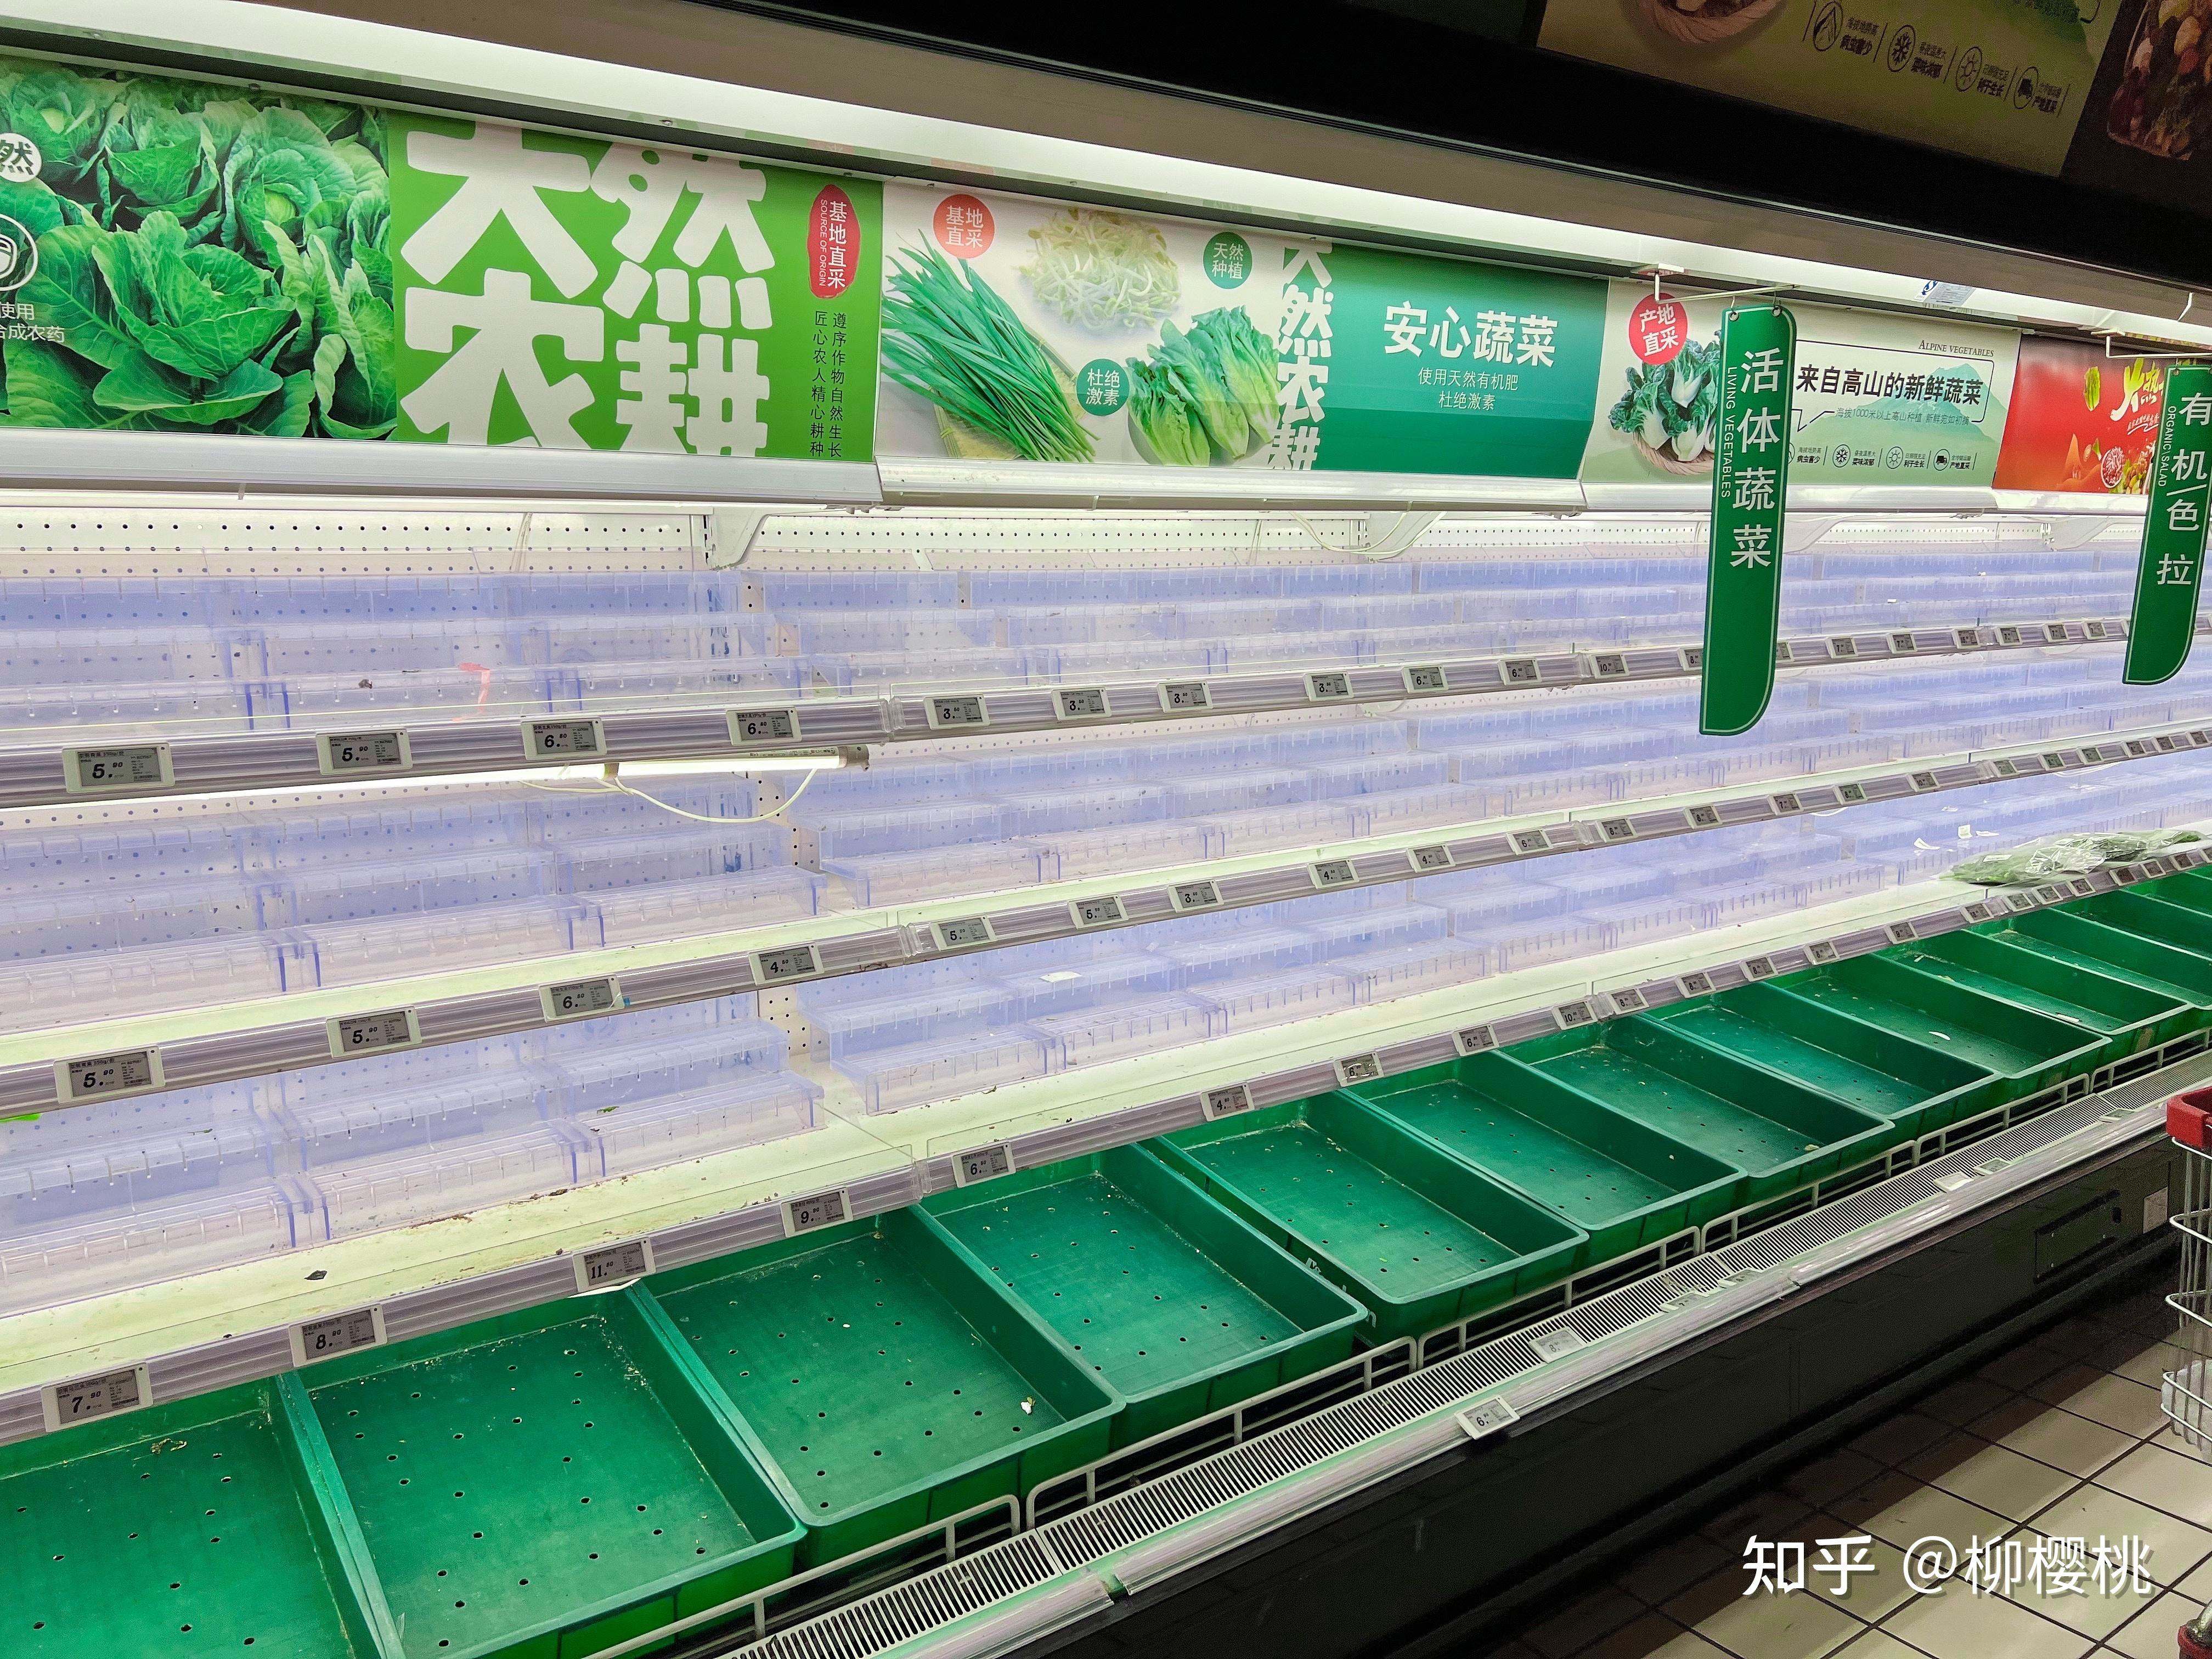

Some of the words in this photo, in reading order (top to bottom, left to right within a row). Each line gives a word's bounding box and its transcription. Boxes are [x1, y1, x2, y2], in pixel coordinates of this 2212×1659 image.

[945, 206, 984, 229] 基地
[820, 240, 827, 253] OF
[827, 200, 848, 289] 基地直采
[945, 225, 984, 249] 直采
[1213, 241, 1244, 262] 天然
[819, 255, 827, 287] ORIGIN
[1212, 259, 1244, 280] 种植
[1639, 303, 1676, 334] 产地
[1383, 300, 1559, 368] 安心蔬菜
[1643, 328, 1679, 357] 直采
[400, 268, 770, 457] 农耕
[1918, 340, 1947, 353] ALPINE
[1949, 345, 1994, 358] VEGETABLES
[810, 311, 828, 457] 匠心农人精心耕种
[828, 312, 847, 458] 遵序作物自然生长
[1086, 368, 1121, 388] 杜绝
[1417, 366, 1519, 392] 使用天然有机肥
[1725, 366, 1738, 410] LIVING
[1796, 364, 1984, 405] 来自高山的新鲜蔬菜
[1086, 386, 1120, 407] 激素
[1438, 390, 1497, 411] 杜绝激素
[1721, 415, 1736, 499] VEGETABLES
[1729, 347, 1784, 569] 活体蔬菜
[71, 1390, 101, 1413] 7.90
